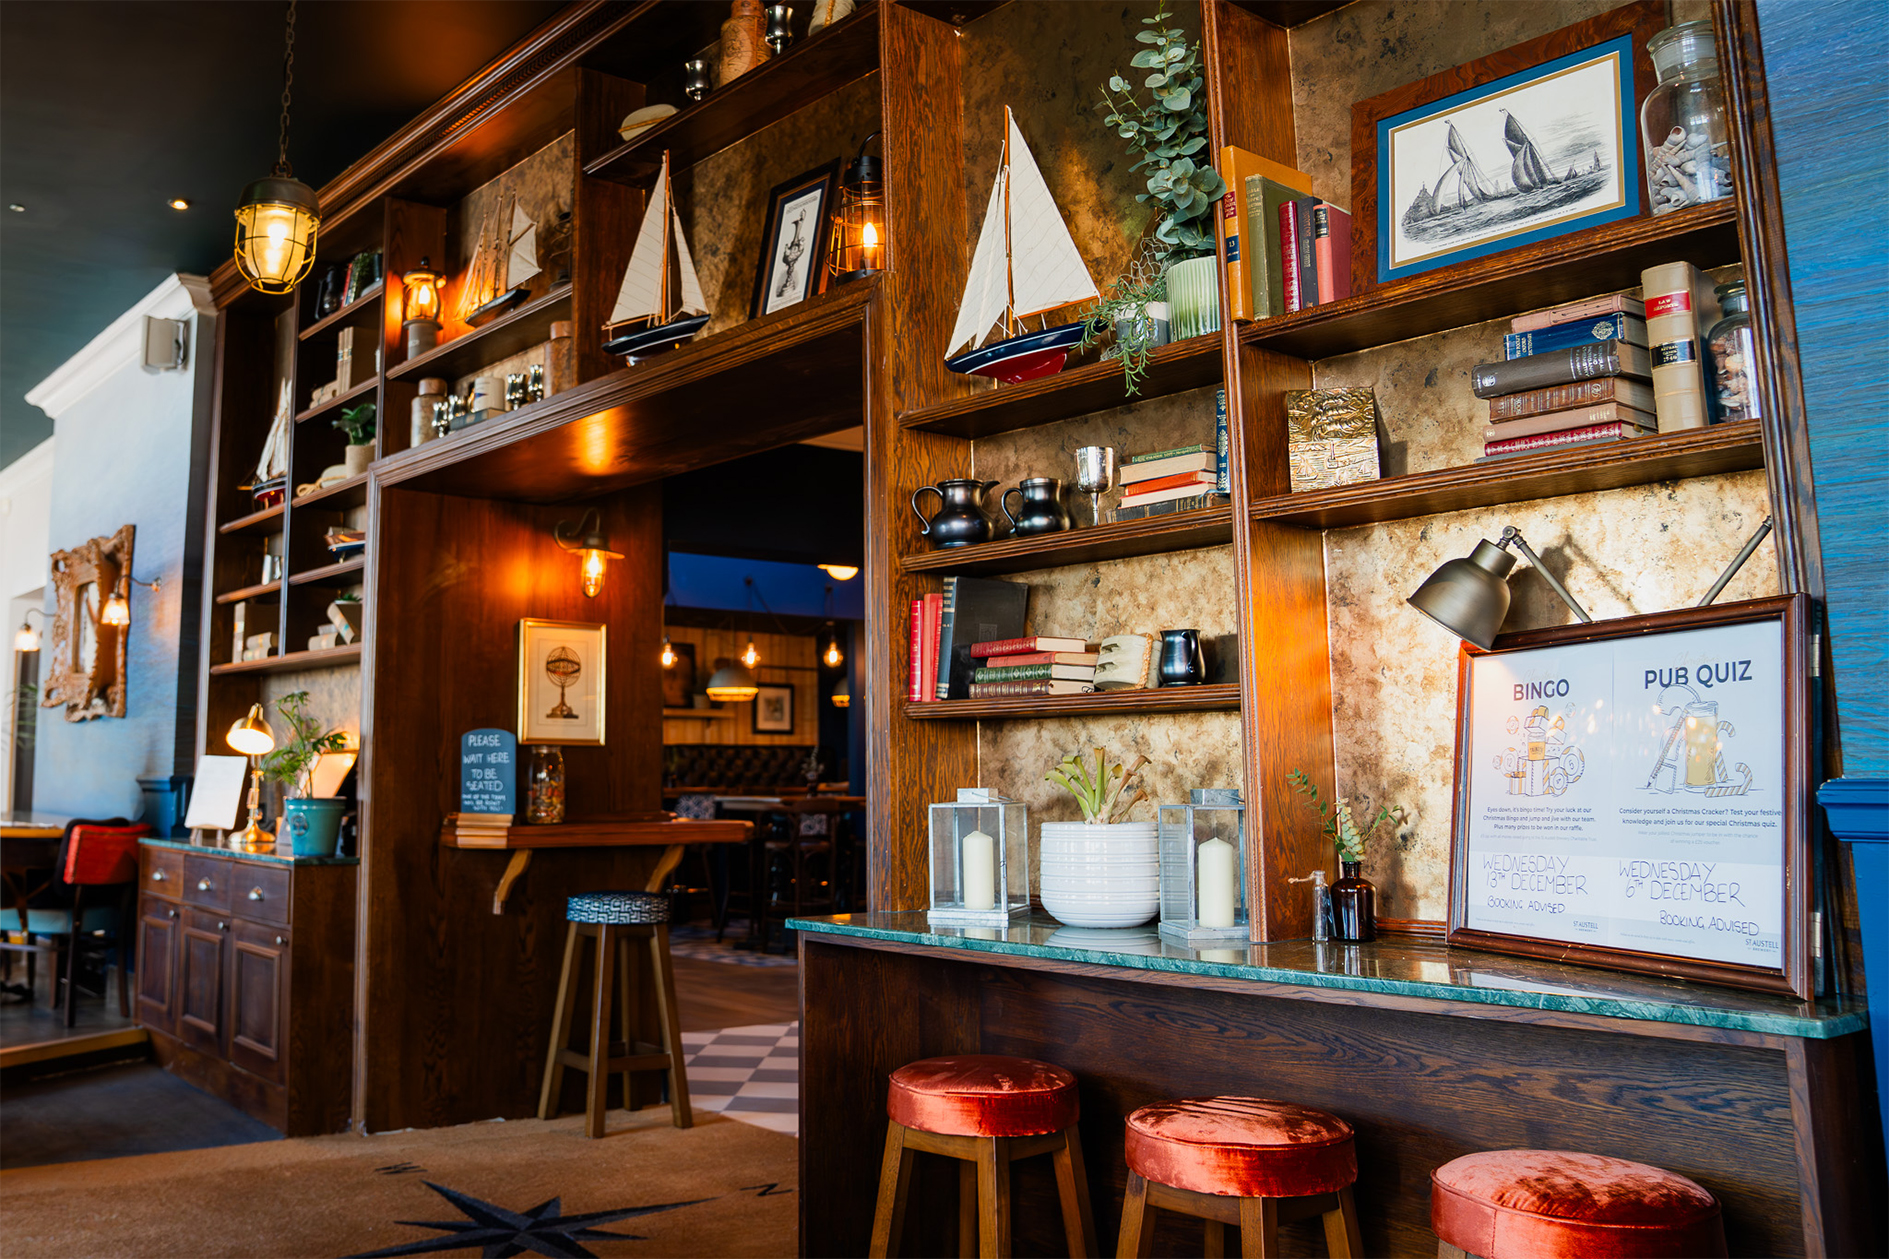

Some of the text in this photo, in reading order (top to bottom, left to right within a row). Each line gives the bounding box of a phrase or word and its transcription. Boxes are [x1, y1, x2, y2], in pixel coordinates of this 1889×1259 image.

[1645, 660, 1752, 689] PUB QUIZ
[1513, 679, 1570, 701] BINGO
[468, 734, 501, 747] PLEASE
[463, 752, 510, 764] WAIT HERE
[471, 768, 498, 780] TO BE
[466, 780, 503, 791] SEATED
[1643, 808, 1666, 816] yourself
[1483, 854, 1569, 874] WEDNESDAY
[1619, 860, 1716, 883] WEDNESDAY
[1487, 871, 1588, 895] 13TH DECEMBER
[1625, 879, 1746, 907] 6TH DECEMBER
[1488, 895, 1565, 914] BOOKING ADVISED
[1660, 910, 1759, 936] BOOKING ADVISED
[1752, 940, 1778, 949] AUSTELL
